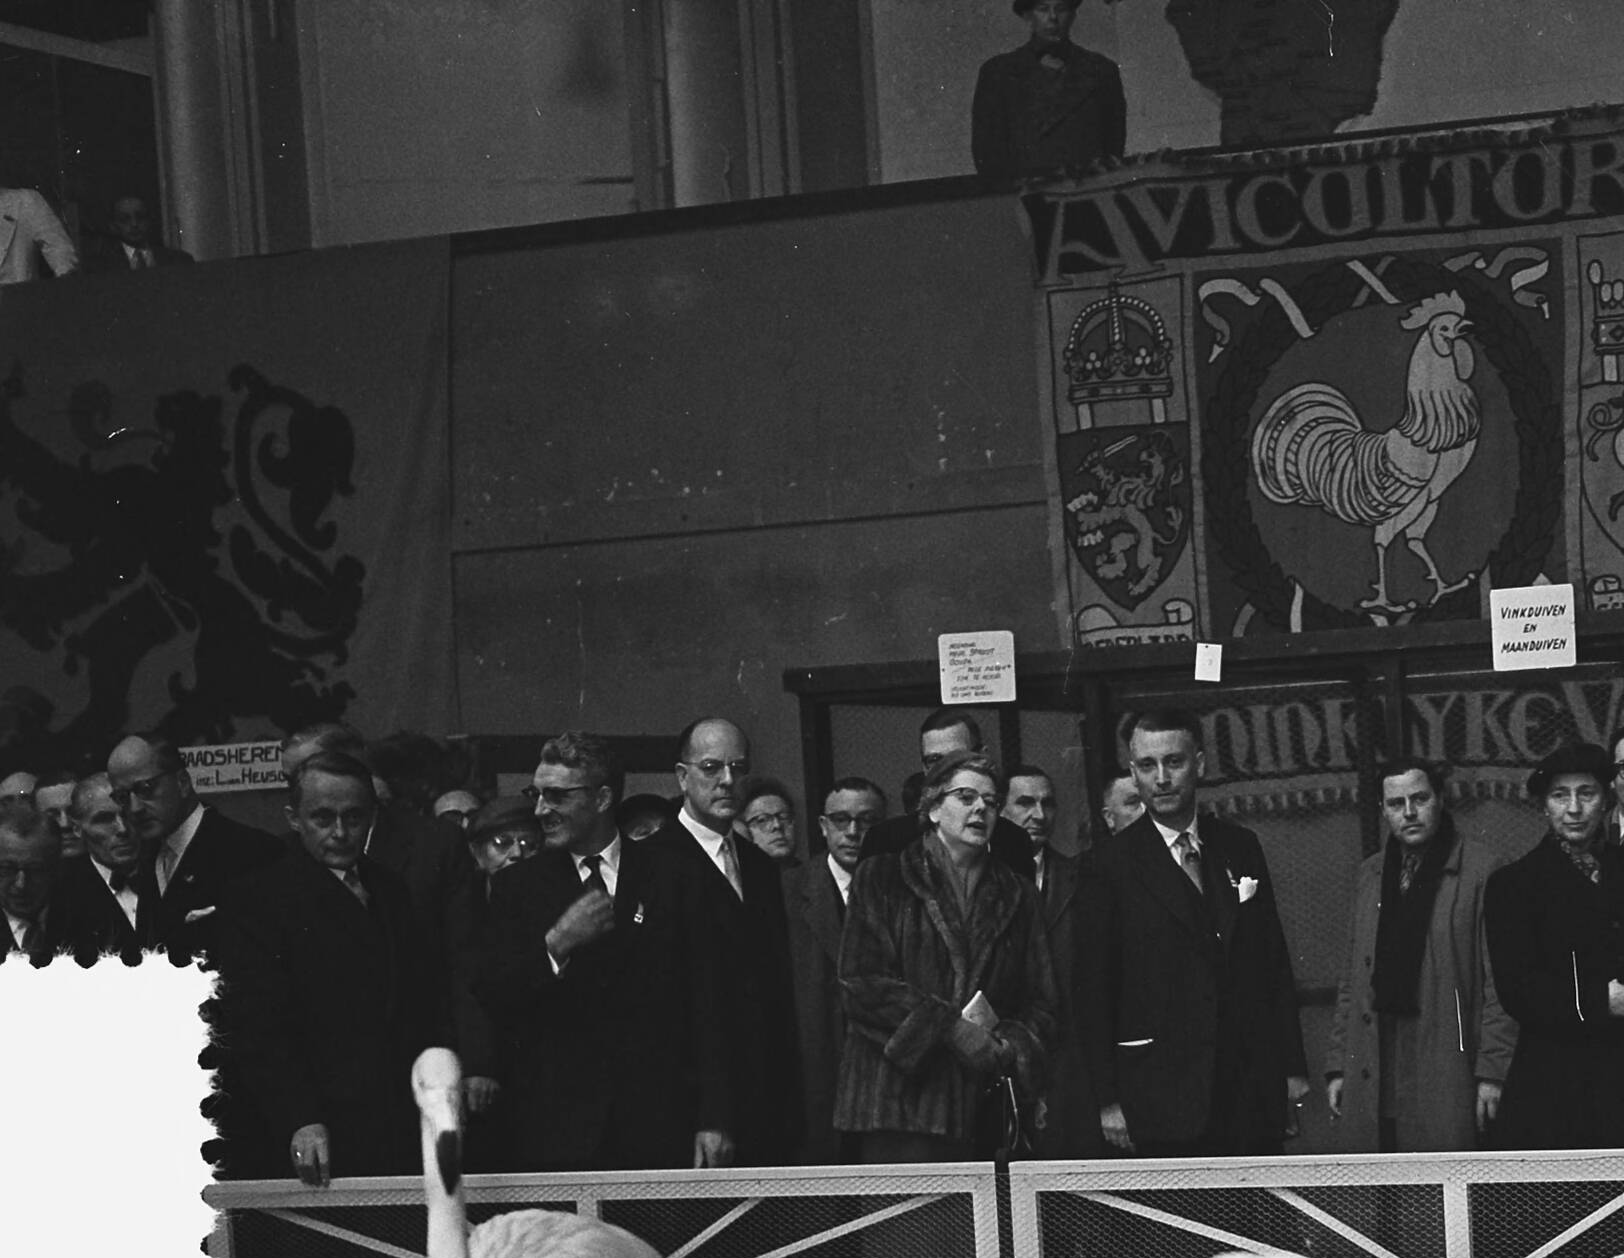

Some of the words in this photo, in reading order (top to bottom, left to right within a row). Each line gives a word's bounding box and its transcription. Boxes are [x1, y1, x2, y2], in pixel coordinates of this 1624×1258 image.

[1501, 604, 1566, 619] VINKDUIVEN
[1523, 623, 1537, 634] EN
[1501, 637, 1567, 654] MAANDUIVEN
